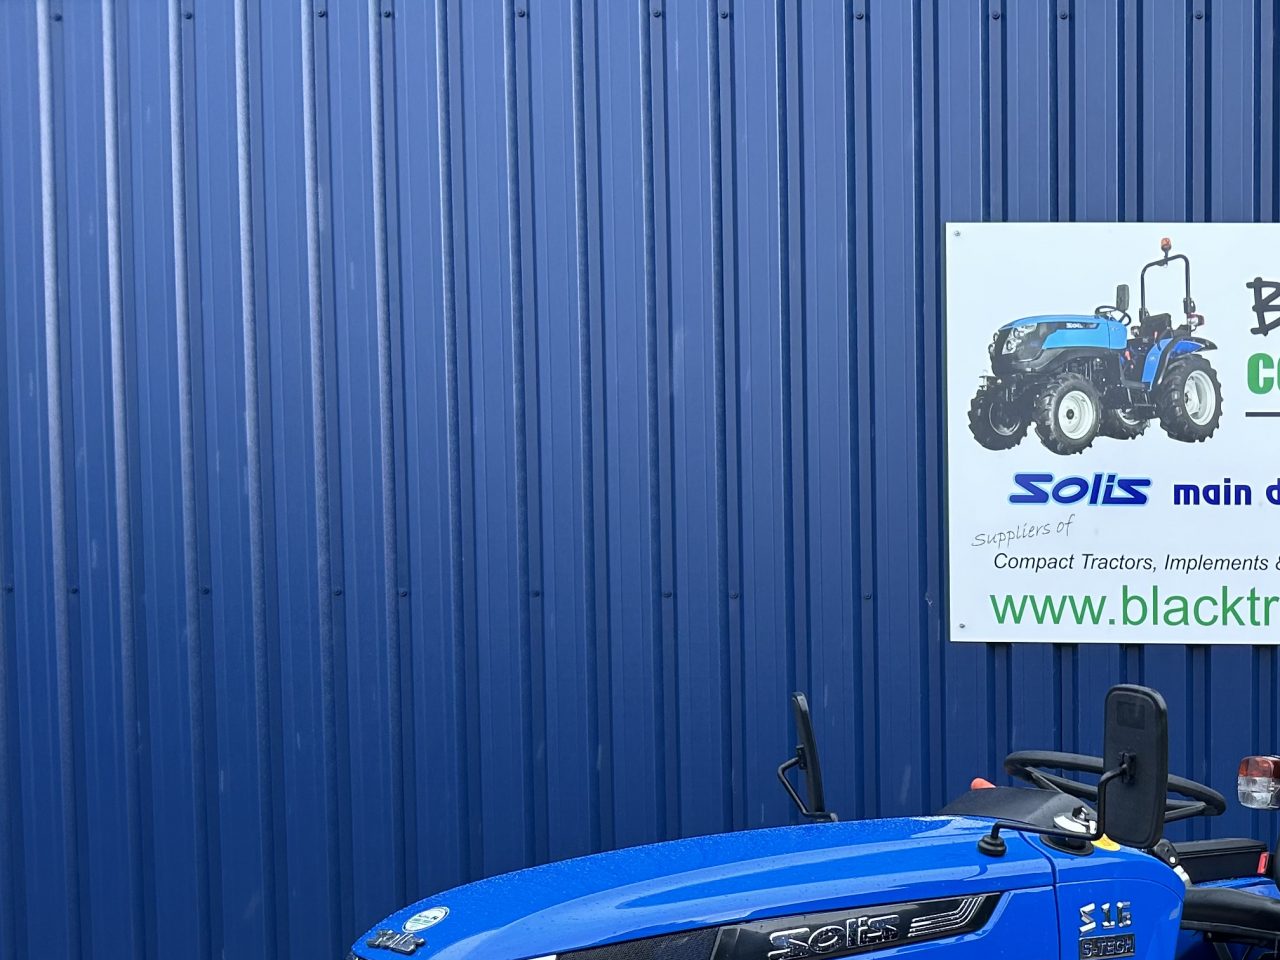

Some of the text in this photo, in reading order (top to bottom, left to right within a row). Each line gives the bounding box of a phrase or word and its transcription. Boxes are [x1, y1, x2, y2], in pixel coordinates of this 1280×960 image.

[1174, 478, 1251, 505] main
[1056, 514, 1075, 536] of
[994, 553, 1074, 573] Compact
[1082, 554, 1157, 573] Tractors,
[1164, 554, 1268, 574] Implements
